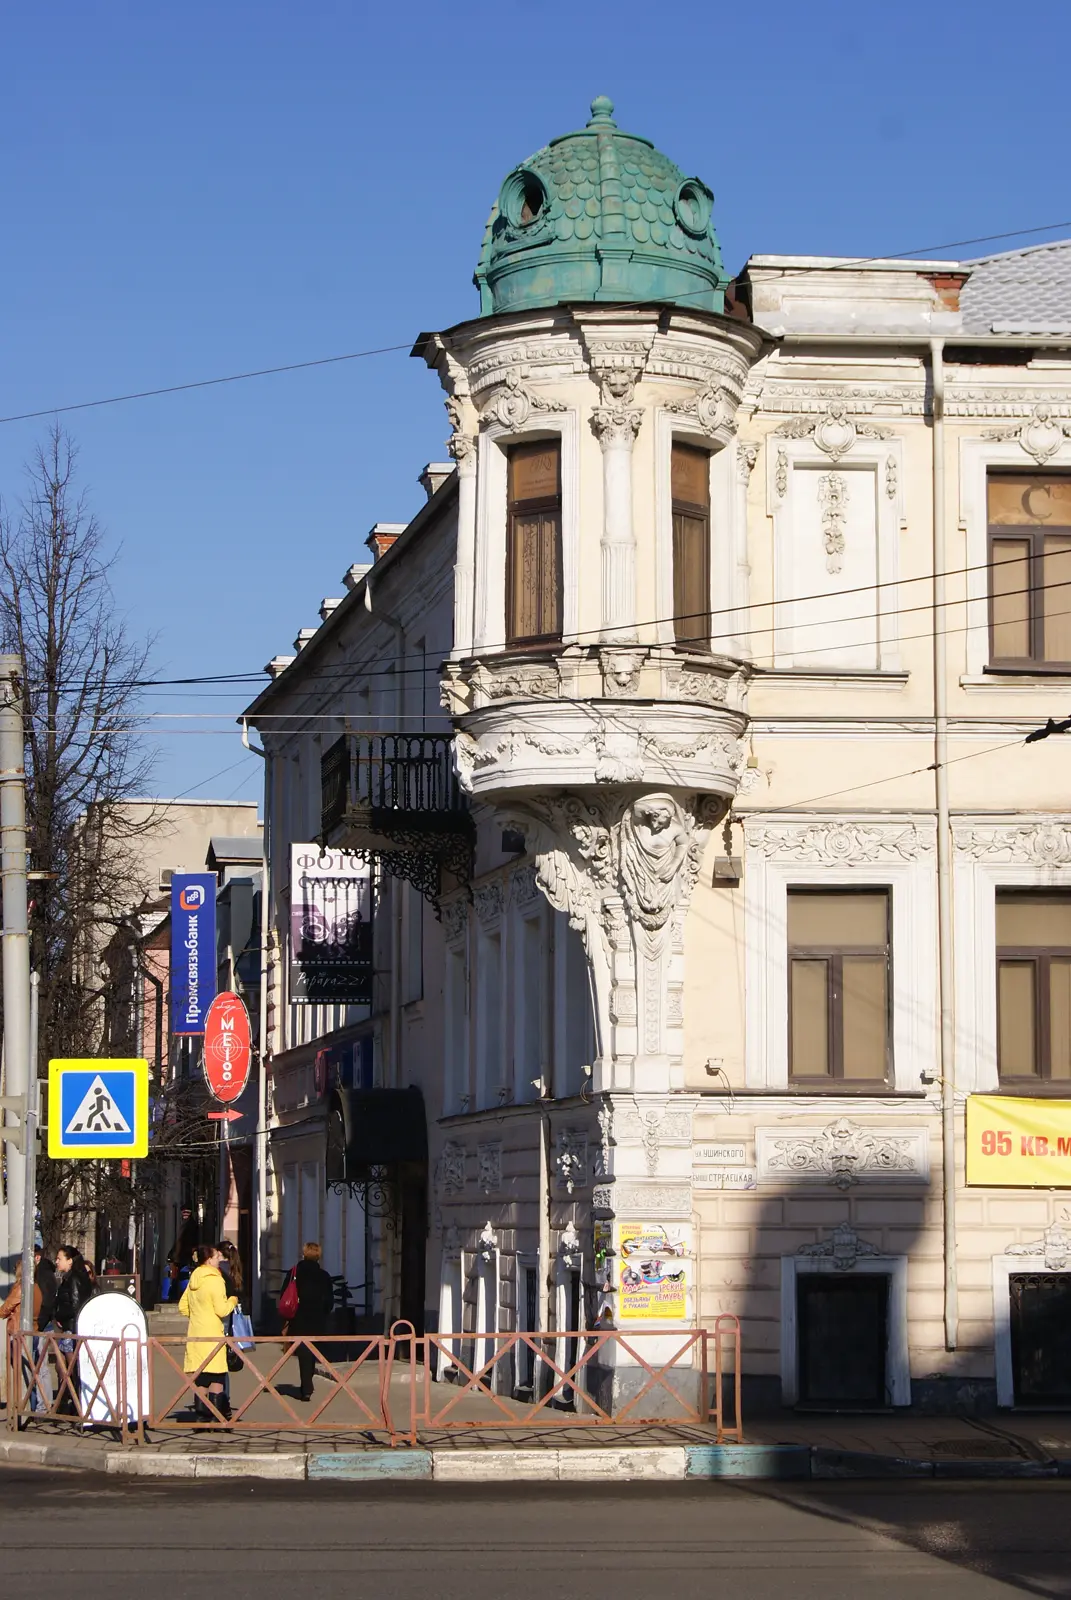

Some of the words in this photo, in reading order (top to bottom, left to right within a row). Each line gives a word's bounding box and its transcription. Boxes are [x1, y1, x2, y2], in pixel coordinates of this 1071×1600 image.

[296, 854, 366, 871] ФОТО
[298, 876, 365, 890] САЛОН
[185, 914, 201, 1024] Промсвязьбанк
[981, 1130, 1012, 1156] 95
[703, 1149, 744, 1158] УШИНСКОГО
[708, 1173, 753, 1183] СТРЕЛЕЦКАЯ
